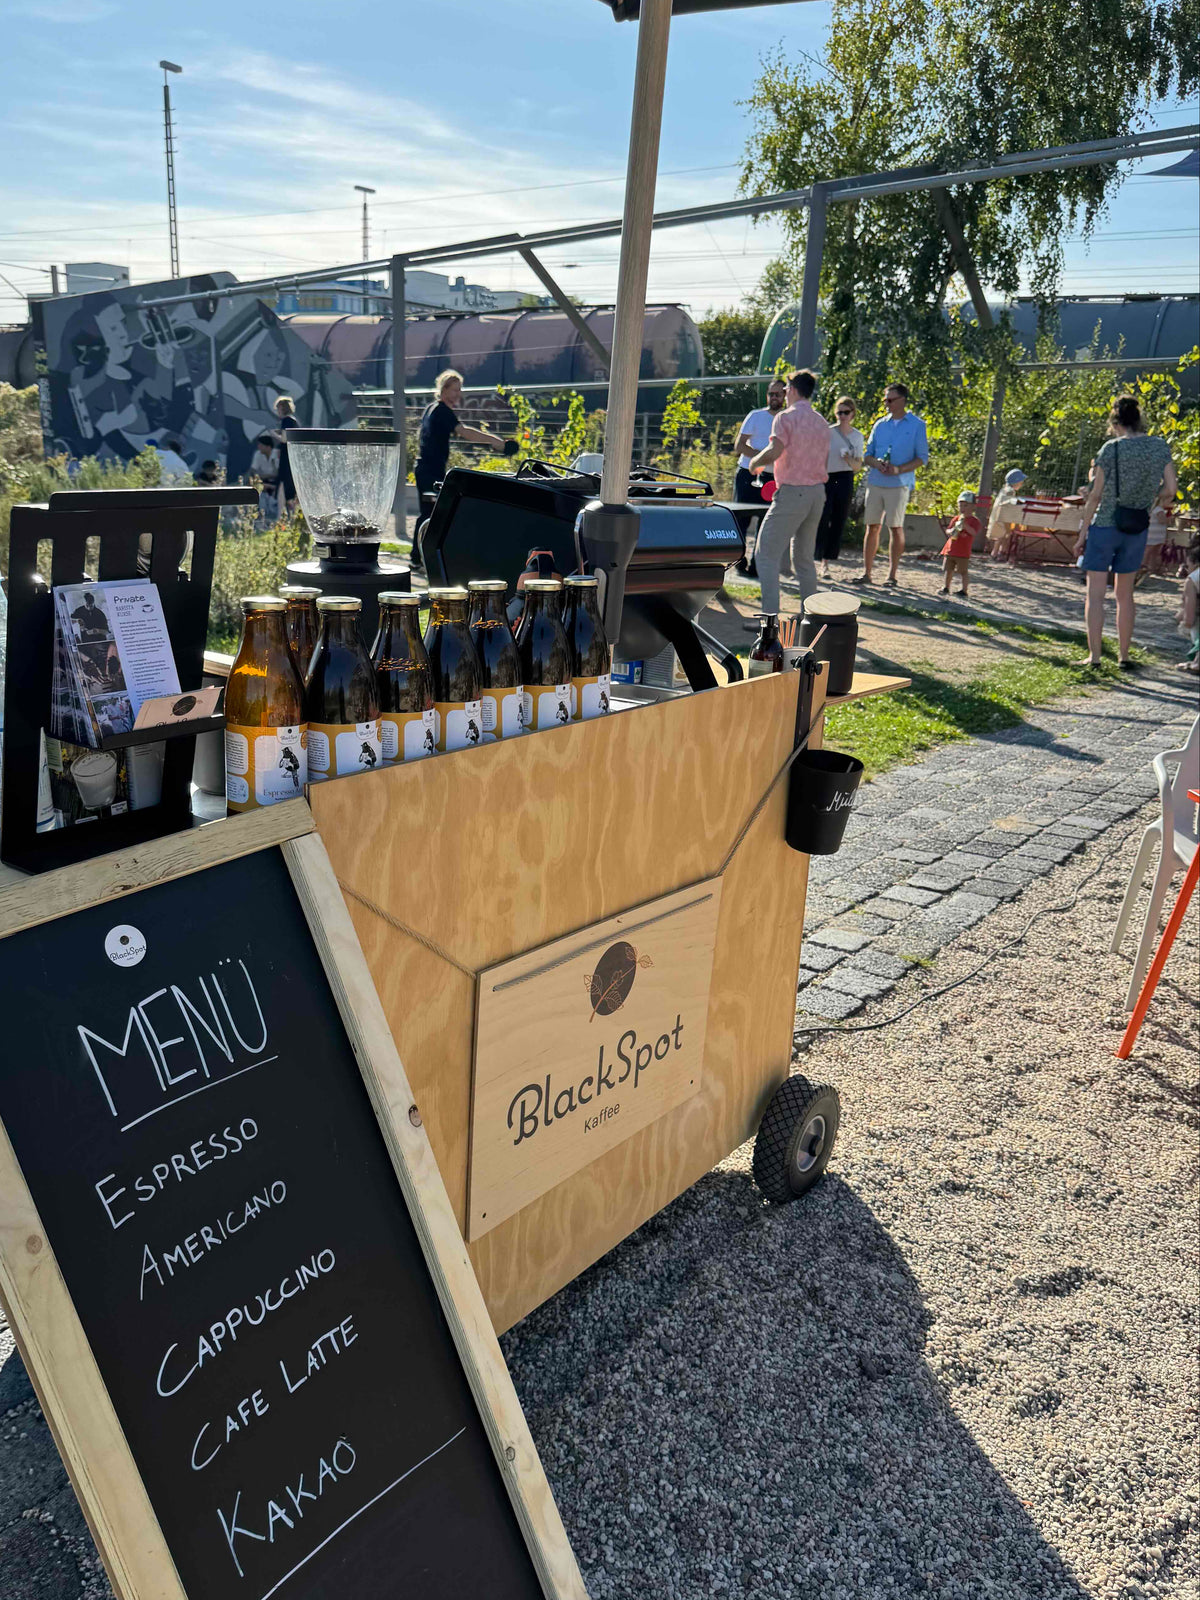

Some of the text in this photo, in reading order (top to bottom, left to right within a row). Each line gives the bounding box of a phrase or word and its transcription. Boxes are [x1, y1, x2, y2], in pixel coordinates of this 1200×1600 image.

[704, 529, 738, 539] SANREMO
[113, 595, 146, 604] Private
[110, 945, 147, 961] BlackSpot
[76, 959, 268, 1117] MENÜ
[507, 1014, 684, 1146] BlackSpot
[95, 1118, 258, 1230] ESPRESSO
[584, 1103, 620, 1133] Kaffee
[140, 1180, 287, 1301] AMERICANO
[156, 1248, 336, 1397] CAPPUCCINO
[191, 1315, 359, 1471] CAFE LATTE
[216, 1440, 356, 1578] KAKAO
